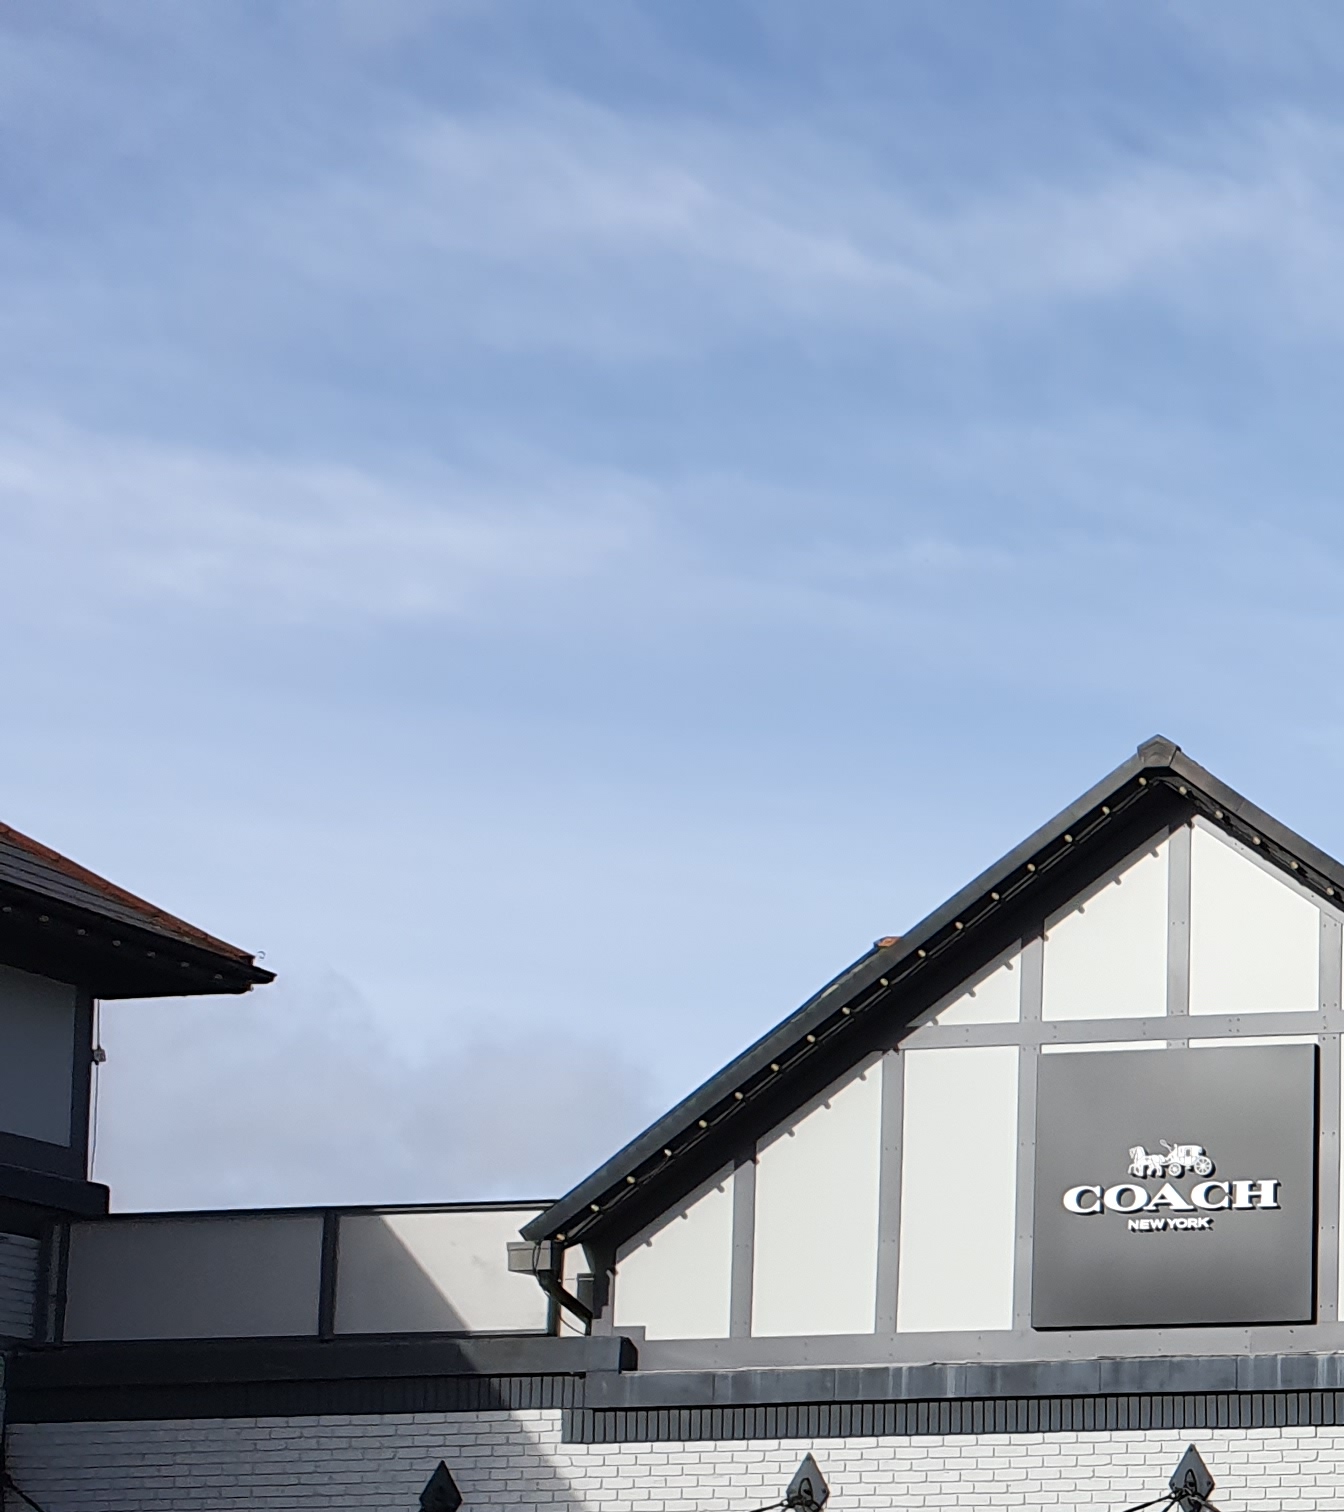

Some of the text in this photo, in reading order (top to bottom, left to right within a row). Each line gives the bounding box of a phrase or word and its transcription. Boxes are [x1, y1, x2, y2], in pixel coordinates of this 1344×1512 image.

[1062, 1180, 1280, 1214] COACH
[1128, 1217, 1211, 1231] NEW YORK
